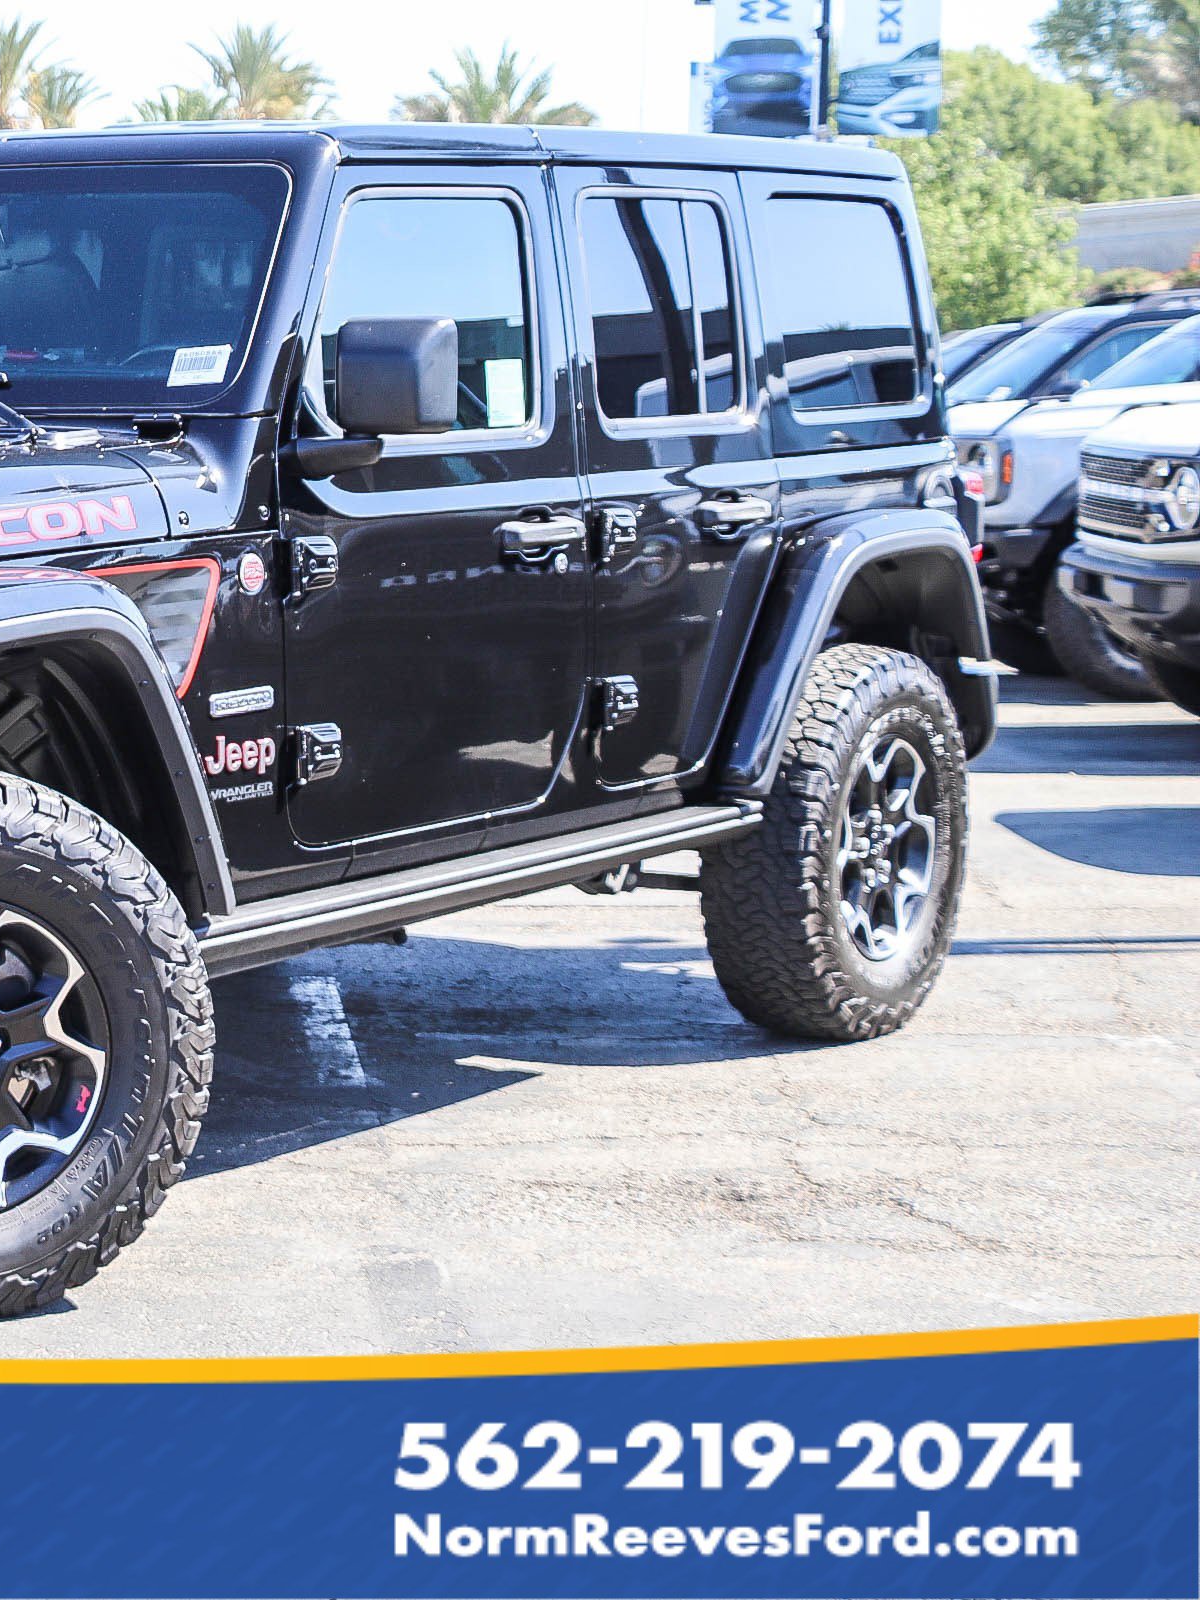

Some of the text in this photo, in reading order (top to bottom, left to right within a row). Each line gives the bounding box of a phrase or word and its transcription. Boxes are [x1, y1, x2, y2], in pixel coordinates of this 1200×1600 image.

[878, 0, 902, 44] EX
[204, 735, 275, 774] Jeep
[226, 790, 274, 802] UNLIMITED
